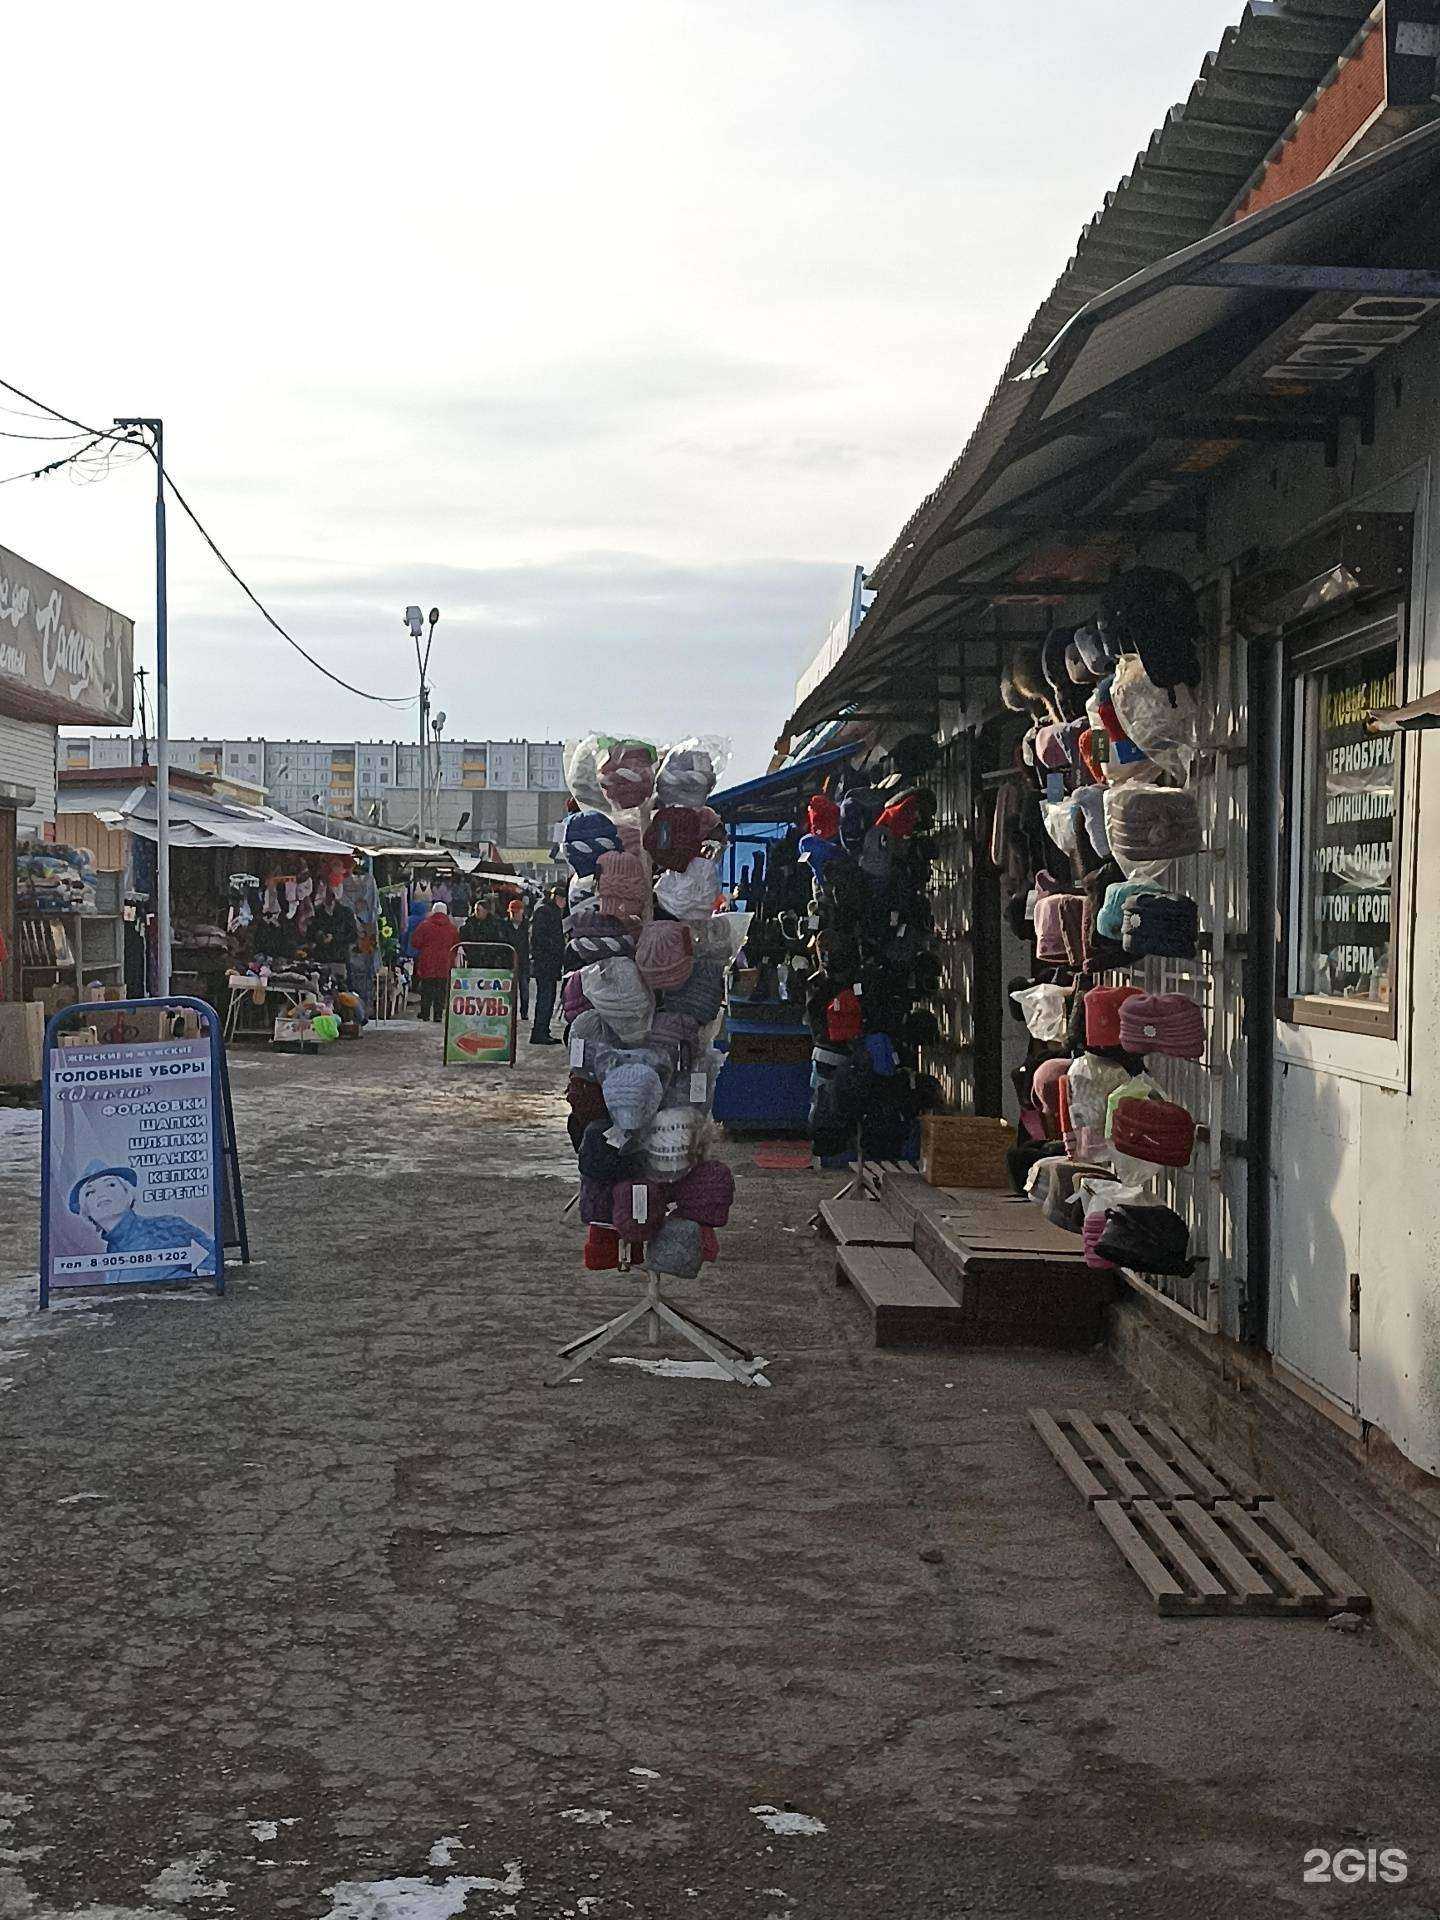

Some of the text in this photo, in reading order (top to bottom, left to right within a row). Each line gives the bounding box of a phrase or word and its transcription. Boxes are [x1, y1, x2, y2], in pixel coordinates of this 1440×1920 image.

[1326, 791, 1394, 825] ШИНШИЛЛА
[1337, 945, 1376, 974] НЕРПА
[452, 996, 510, 1016] ОБУВЬ
[66, 1052, 121, 1062] ЖЕНСКИЕ
[136, 1045, 193, 1058] МУЖСКИЕ
[55, 1062, 205, 1083] ГОЛОВНЫЕ УБОРЫ
[103, 1097, 207, 1117] ФОРМОВКИ
[140, 1115, 207, 1131] ШАПКИ
[129, 1133, 208, 1150] ШЛЯПКИ
[129, 1150, 208, 1168] УШАНКИ
[149, 1167, 208, 1184] КЕПКИ
[143, 1184, 208, 1203] БЕРЕТЫ
